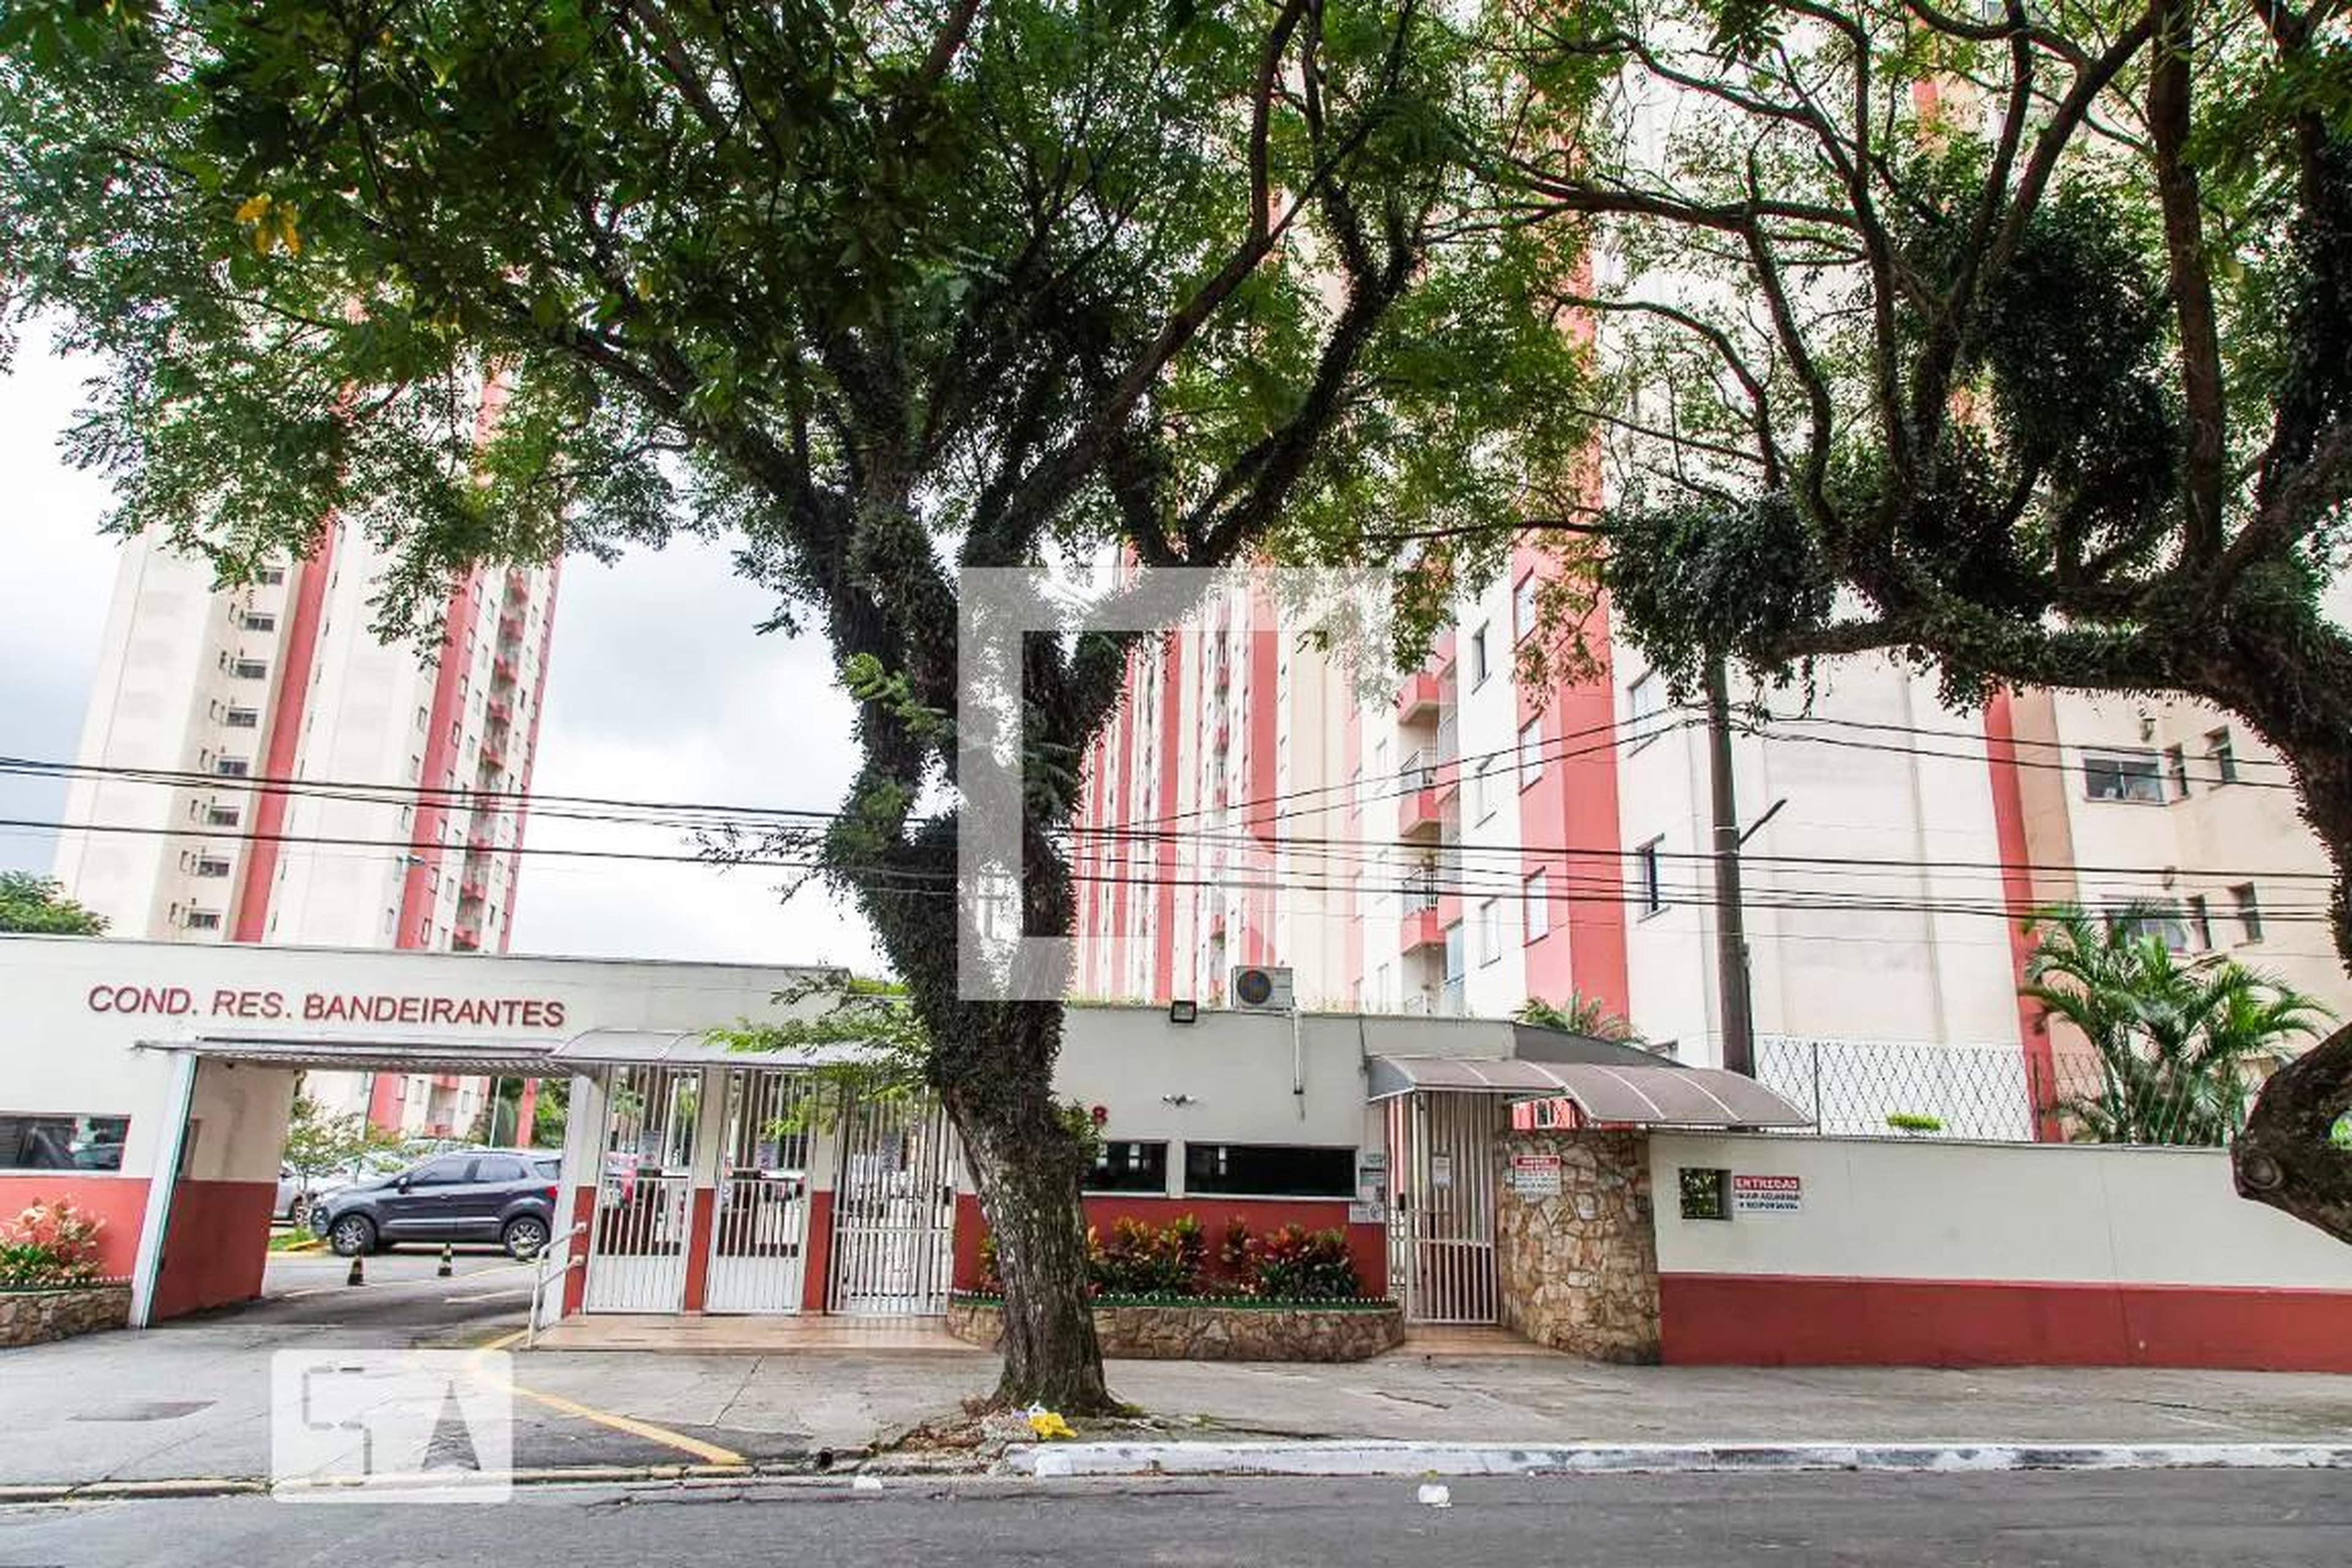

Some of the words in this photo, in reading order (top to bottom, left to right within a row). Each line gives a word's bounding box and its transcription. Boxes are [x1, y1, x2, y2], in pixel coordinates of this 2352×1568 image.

[88, 986, 197, 1017] COND.
[212, 989, 292, 1019] RES.
[303, 993, 565, 1028] BANDEIRANTES
